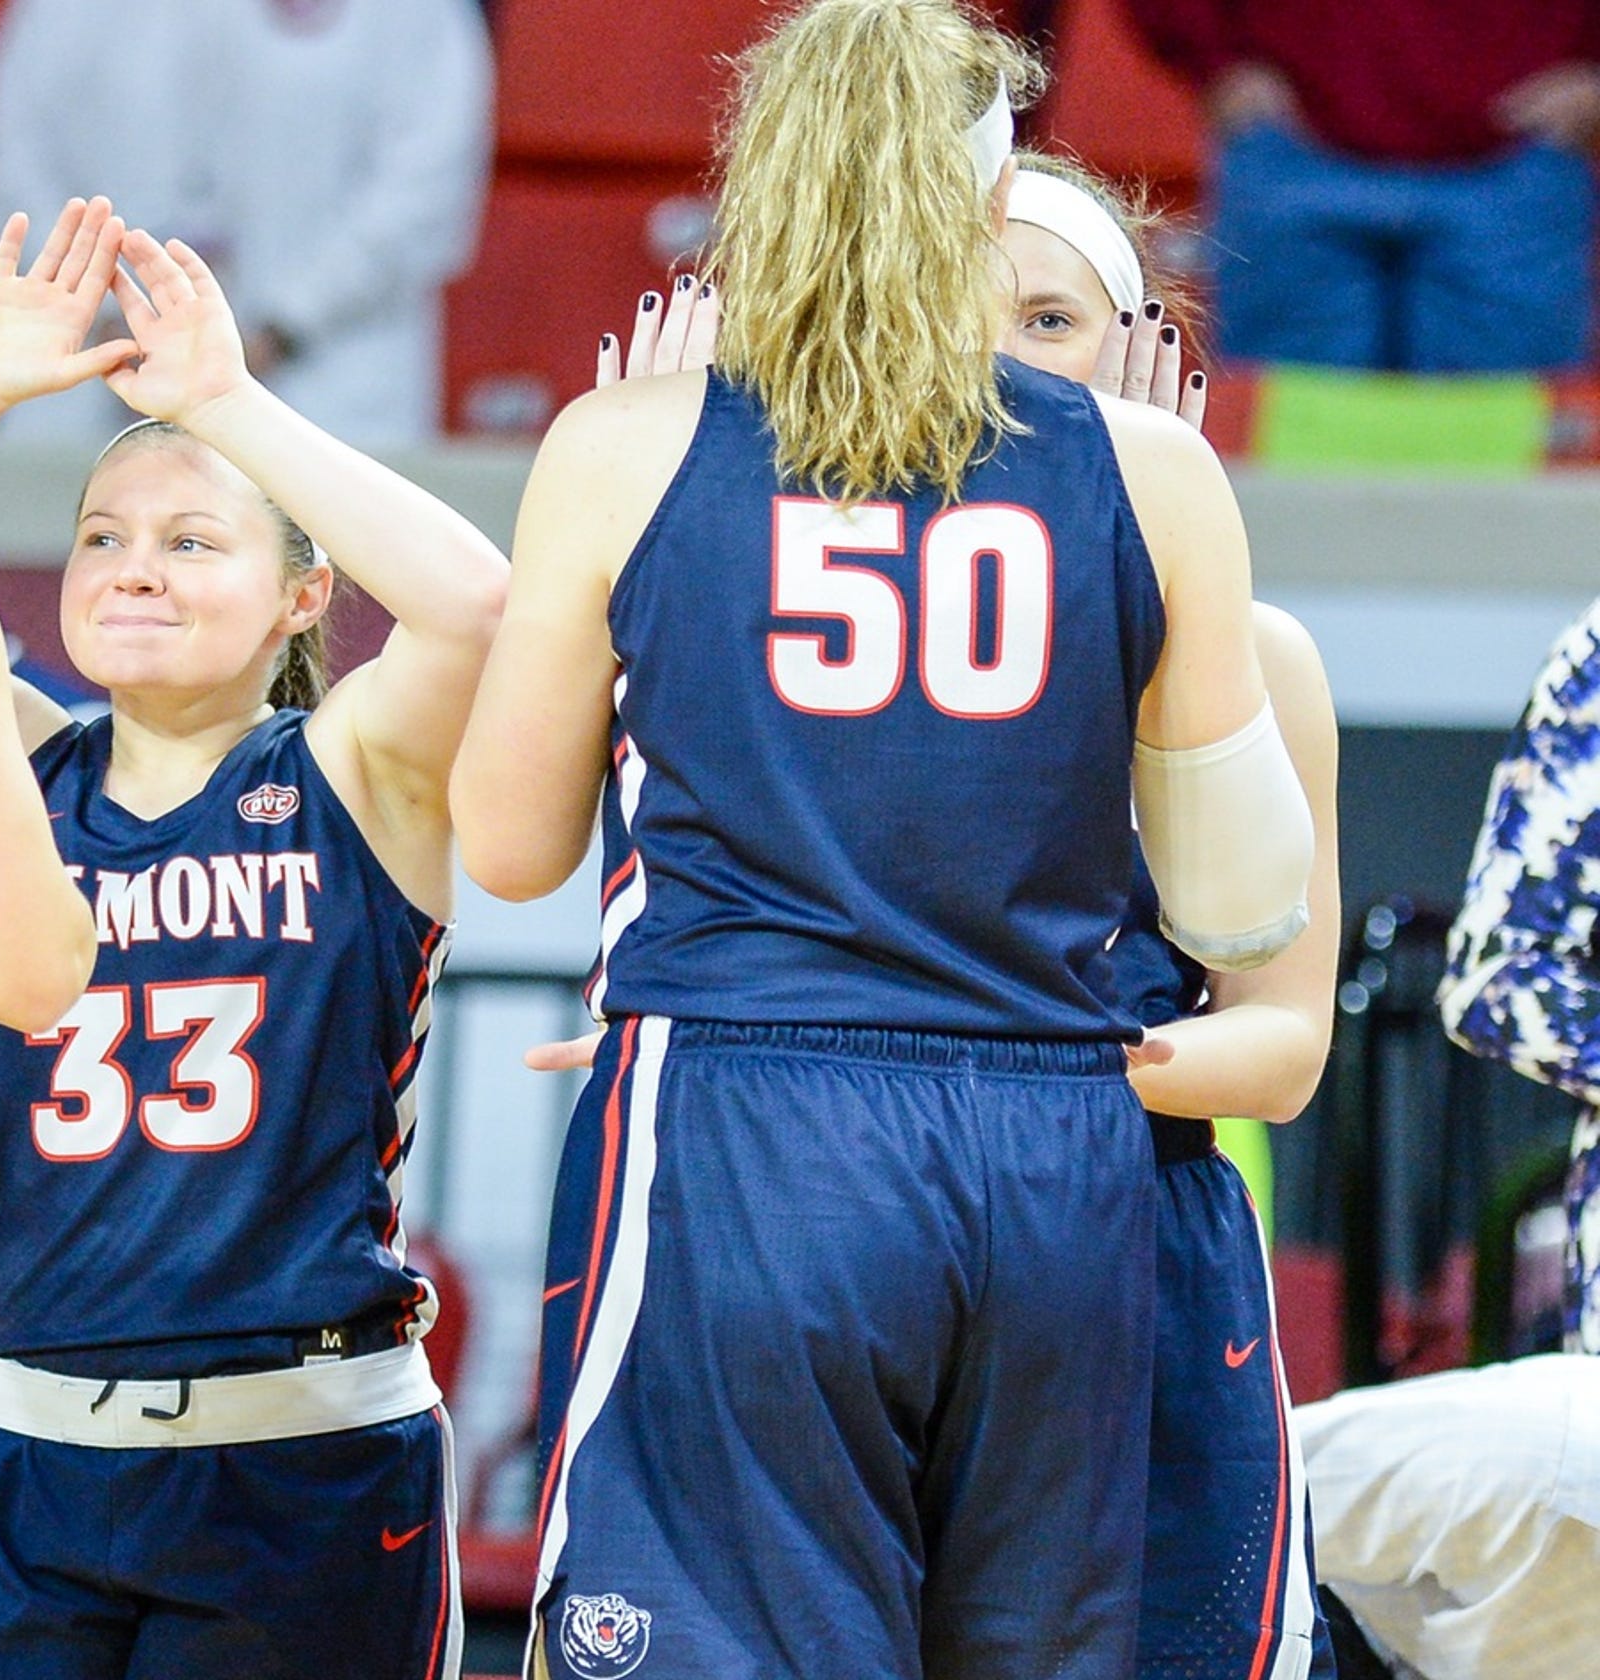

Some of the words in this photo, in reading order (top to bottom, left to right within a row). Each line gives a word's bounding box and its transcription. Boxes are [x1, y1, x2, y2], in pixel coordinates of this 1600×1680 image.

[766, 495, 1056, 721] 50
[66, 851, 321, 951] MONT
[25, 976, 267, 1162] 33
[321, 1328, 342, 1349] M
